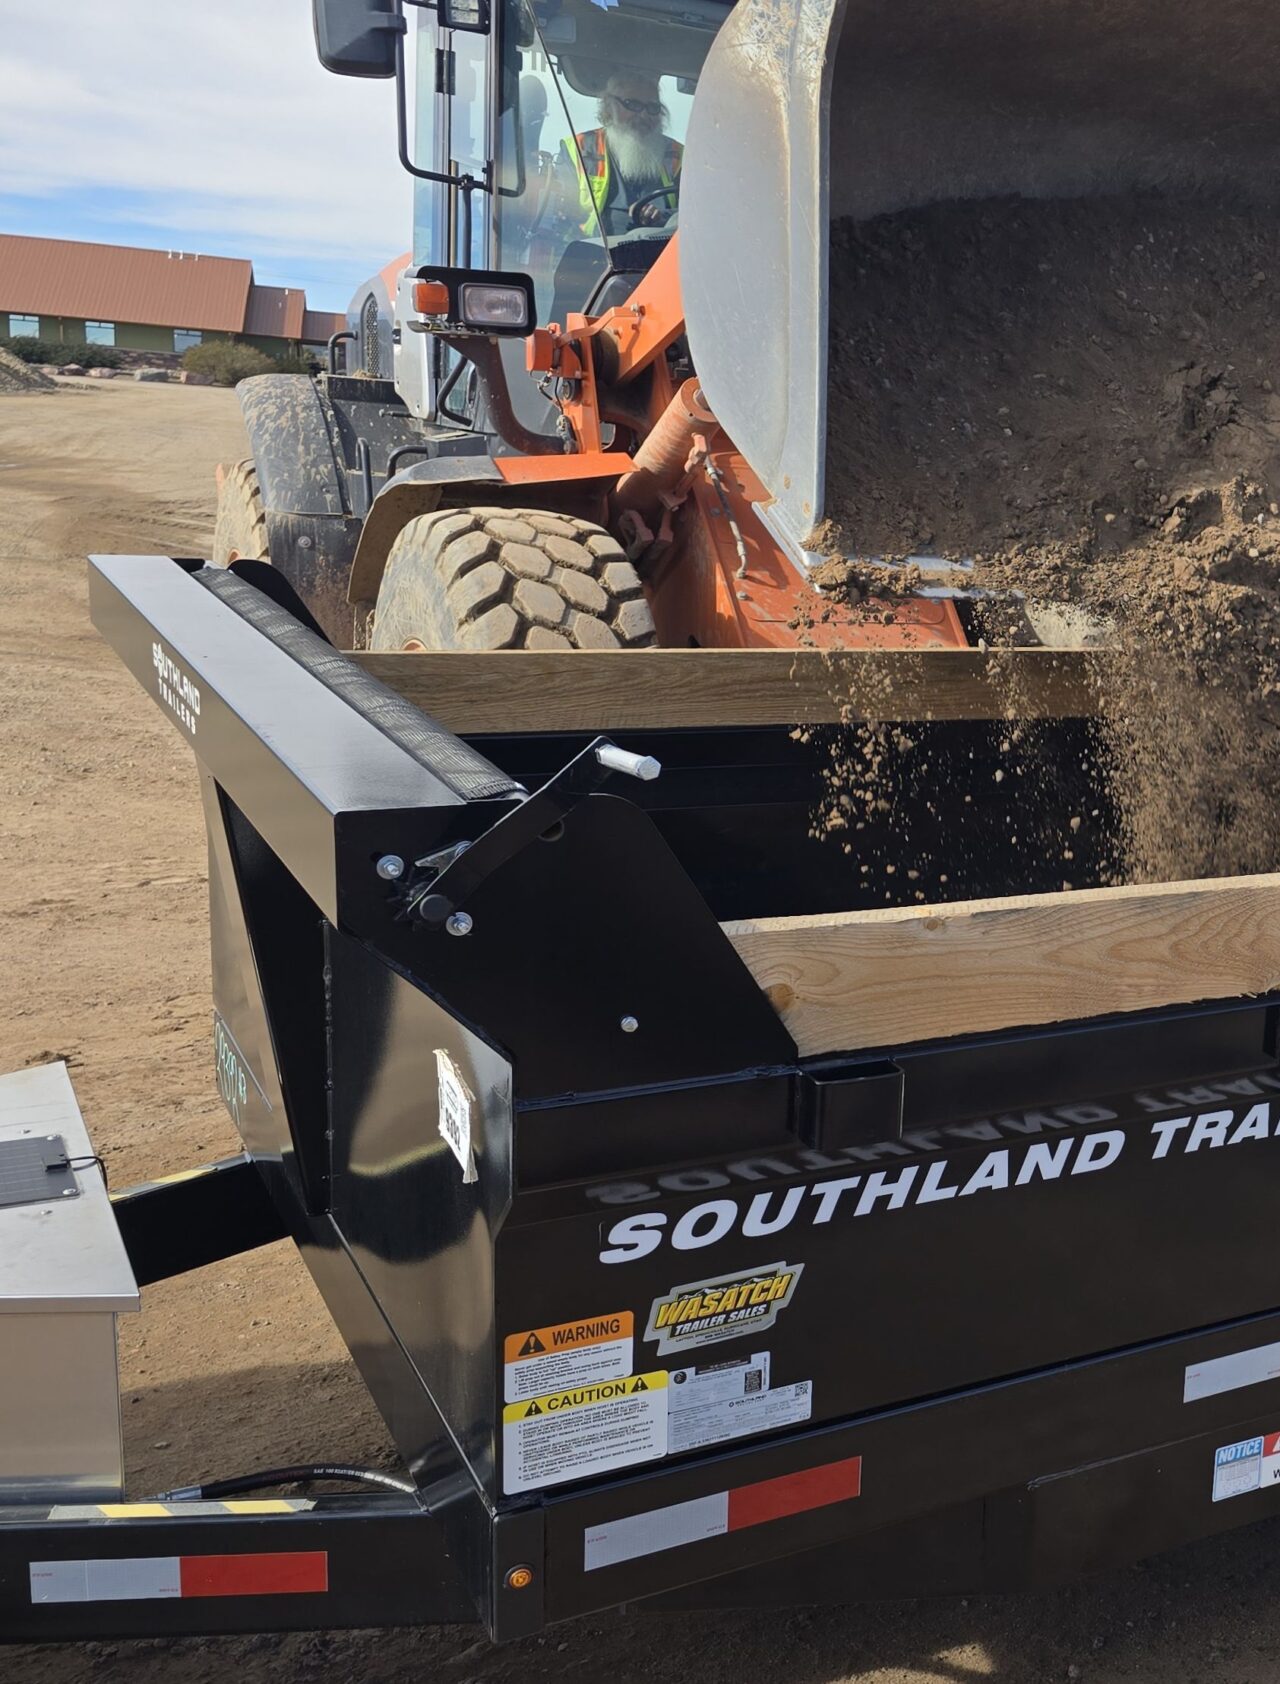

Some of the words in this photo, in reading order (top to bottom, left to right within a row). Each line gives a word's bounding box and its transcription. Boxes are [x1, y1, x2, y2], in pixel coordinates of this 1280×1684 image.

[158, 677, 196, 735] TRAILERS
[599, 1130, 1125, 1264] SOUTHLAND
[655, 1274, 793, 1329] WASATCH
[552, 1319, 620, 1346] WARNING
[674, 1314, 726, 1336] TRAILER
[728, 1304, 767, 1322] SALES
[547, 1383, 626, 1411] CAUTION
[1218, 1440, 1262, 1463] NOTICE
